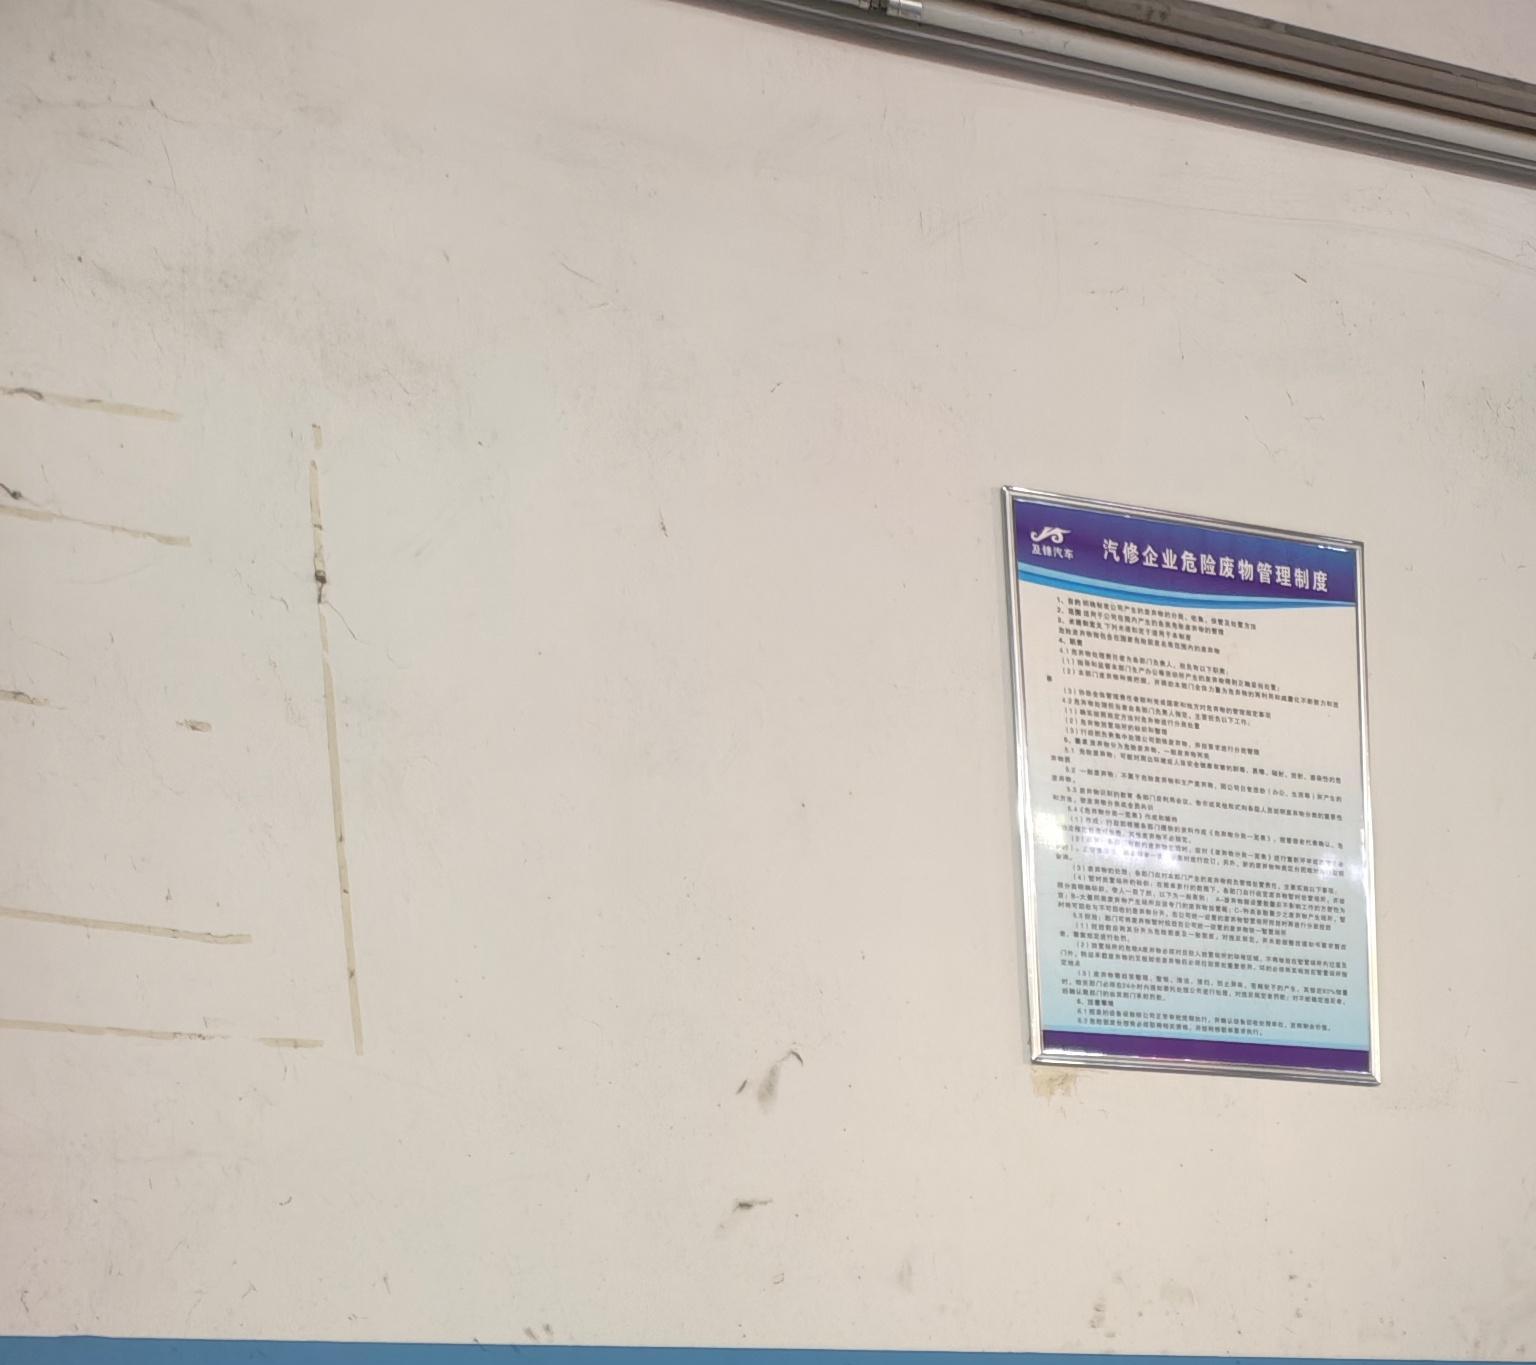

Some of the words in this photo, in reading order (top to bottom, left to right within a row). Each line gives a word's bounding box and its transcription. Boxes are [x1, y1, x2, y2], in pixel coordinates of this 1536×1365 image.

[1103, 538, 1328, 592] 汽修企业危险废物管理制度
